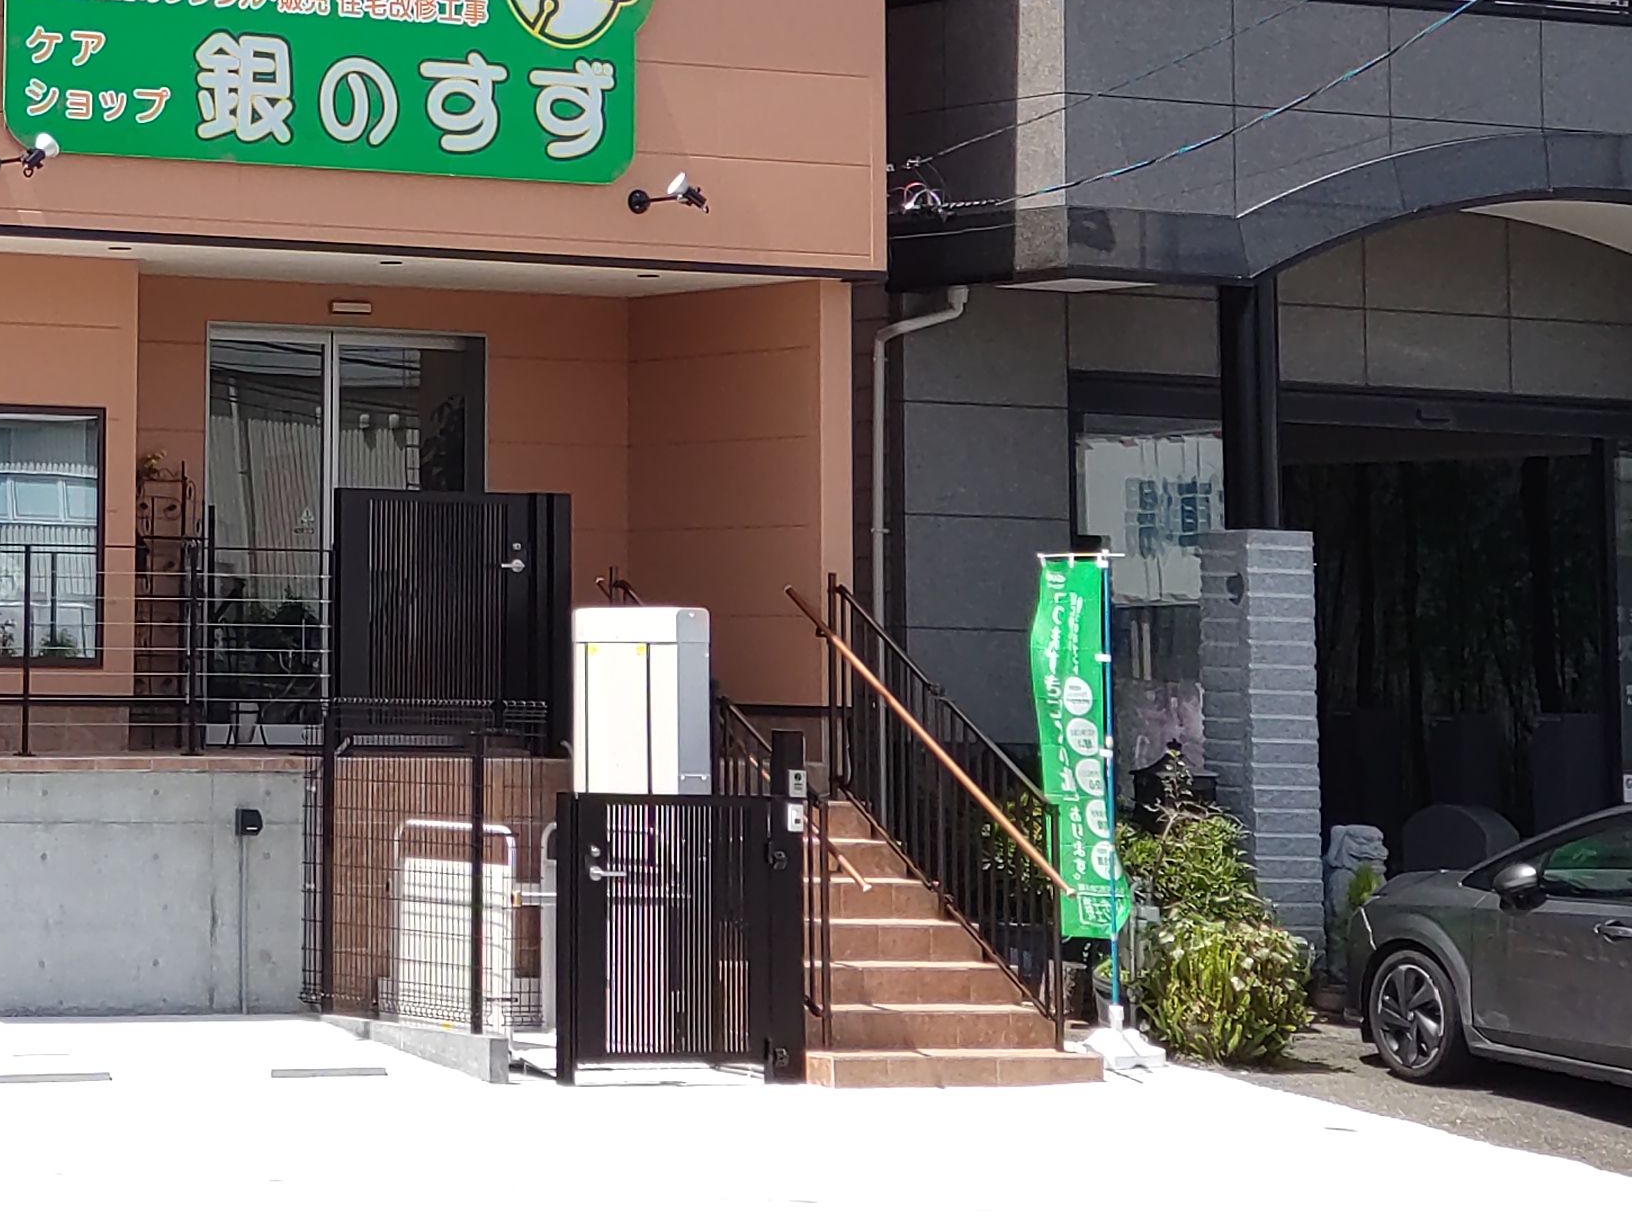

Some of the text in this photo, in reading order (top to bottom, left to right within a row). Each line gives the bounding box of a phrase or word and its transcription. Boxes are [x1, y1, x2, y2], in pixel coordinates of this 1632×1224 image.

[25, 25, 106, 66] ケア
[25, 78, 171, 124] ショップ
[193, 29, 615, 160] 銀のすず
